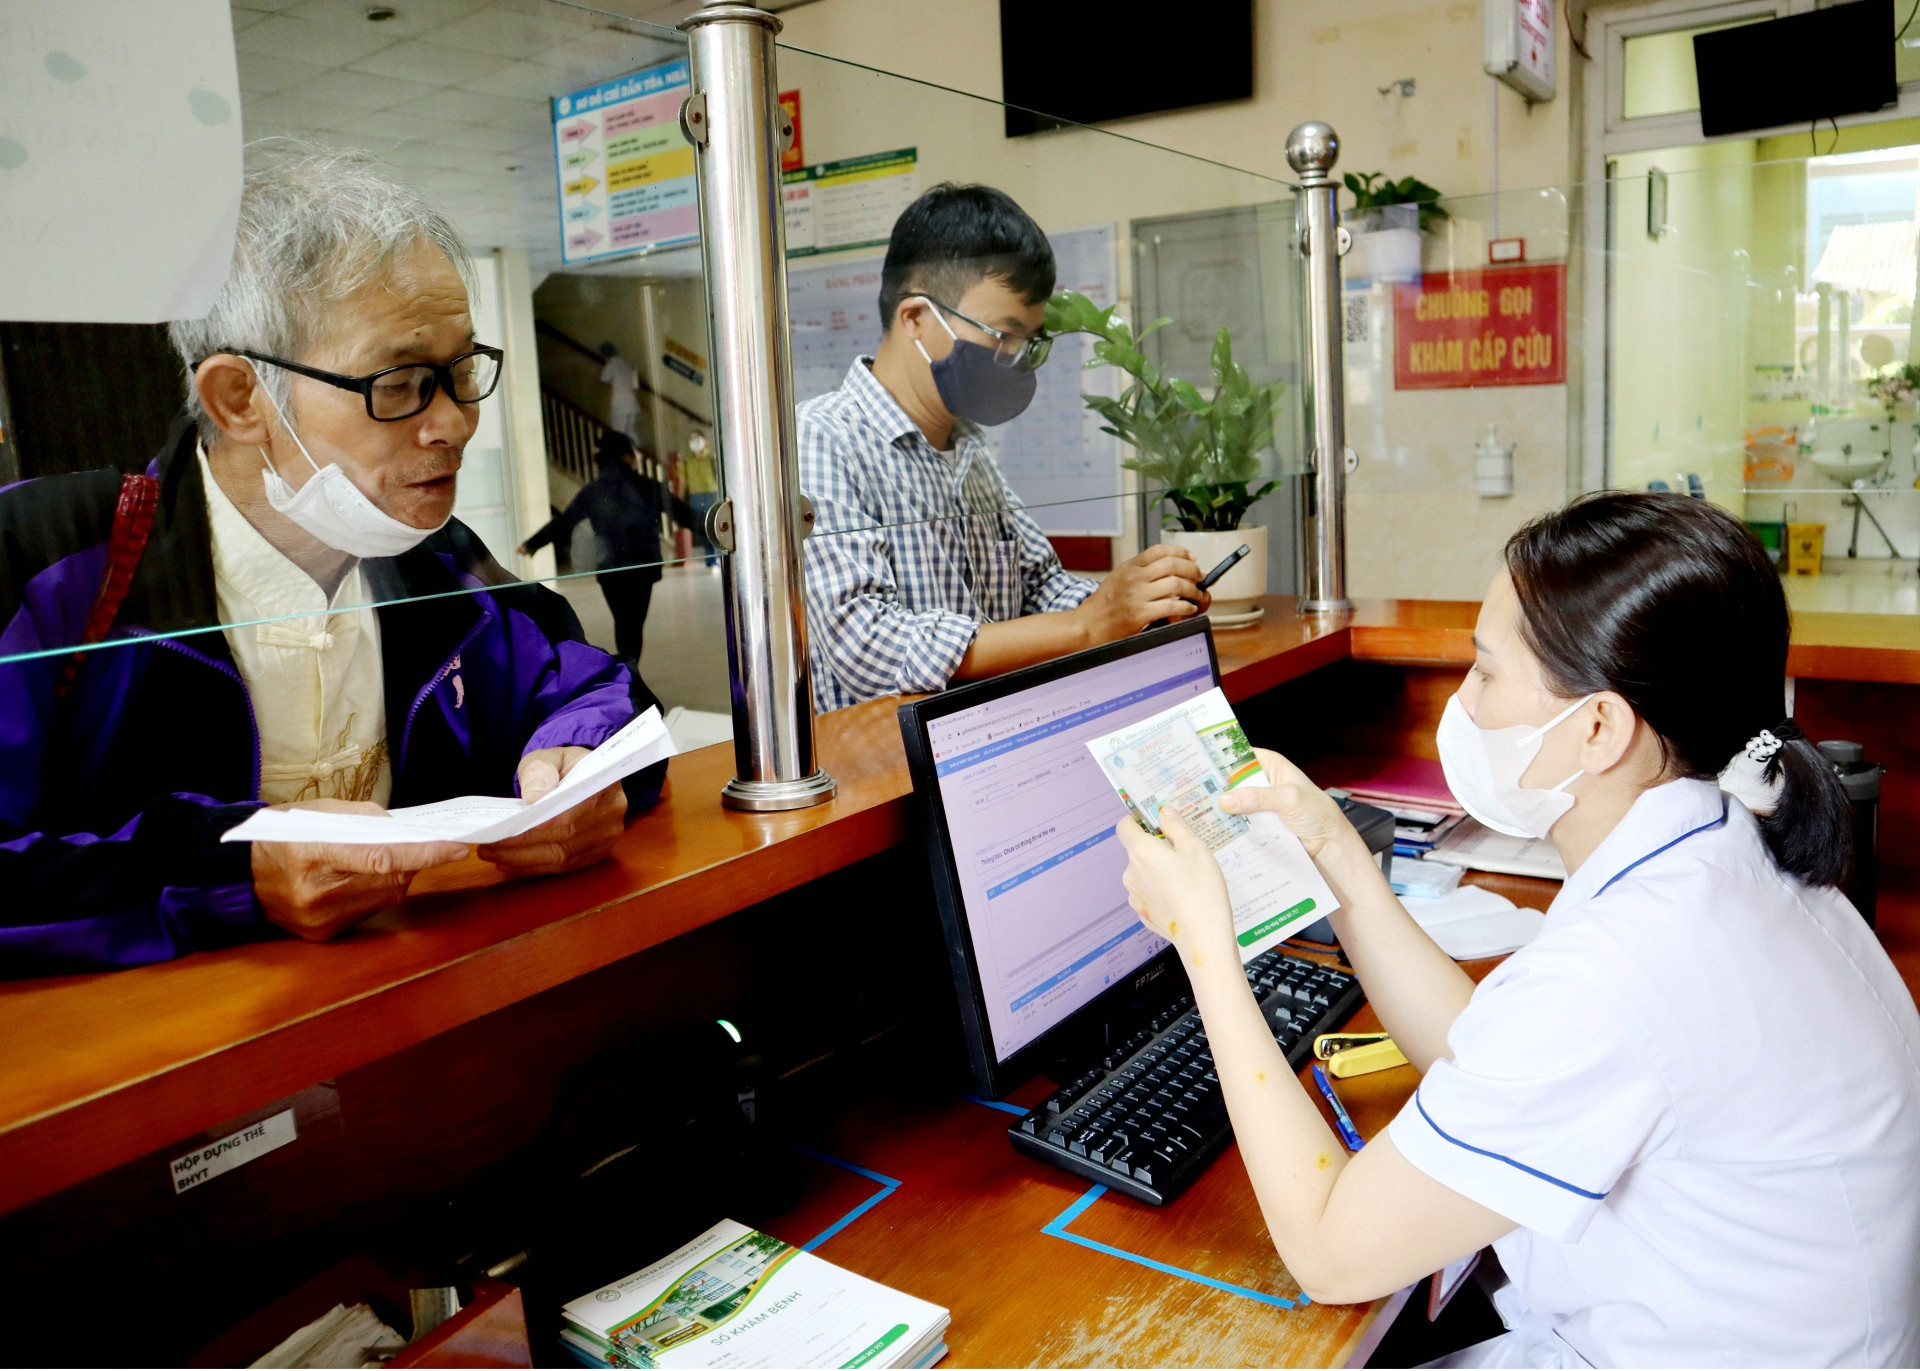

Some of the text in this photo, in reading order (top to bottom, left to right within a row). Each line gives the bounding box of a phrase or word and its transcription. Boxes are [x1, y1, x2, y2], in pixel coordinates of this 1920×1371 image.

[1500, 286, 1533, 320] GỌI
[1410, 334, 1464, 374] KHÁM
[1469, 330, 1507, 371] CẤP
[1135, 972, 1151, 990] FPT
[174, 1122, 266, 1174] HỘP ĐỰNG THẺ
[177, 1168, 209, 1190] BHYT
[711, 1291, 803, 1346] SỔ KHÁM BỆNH
